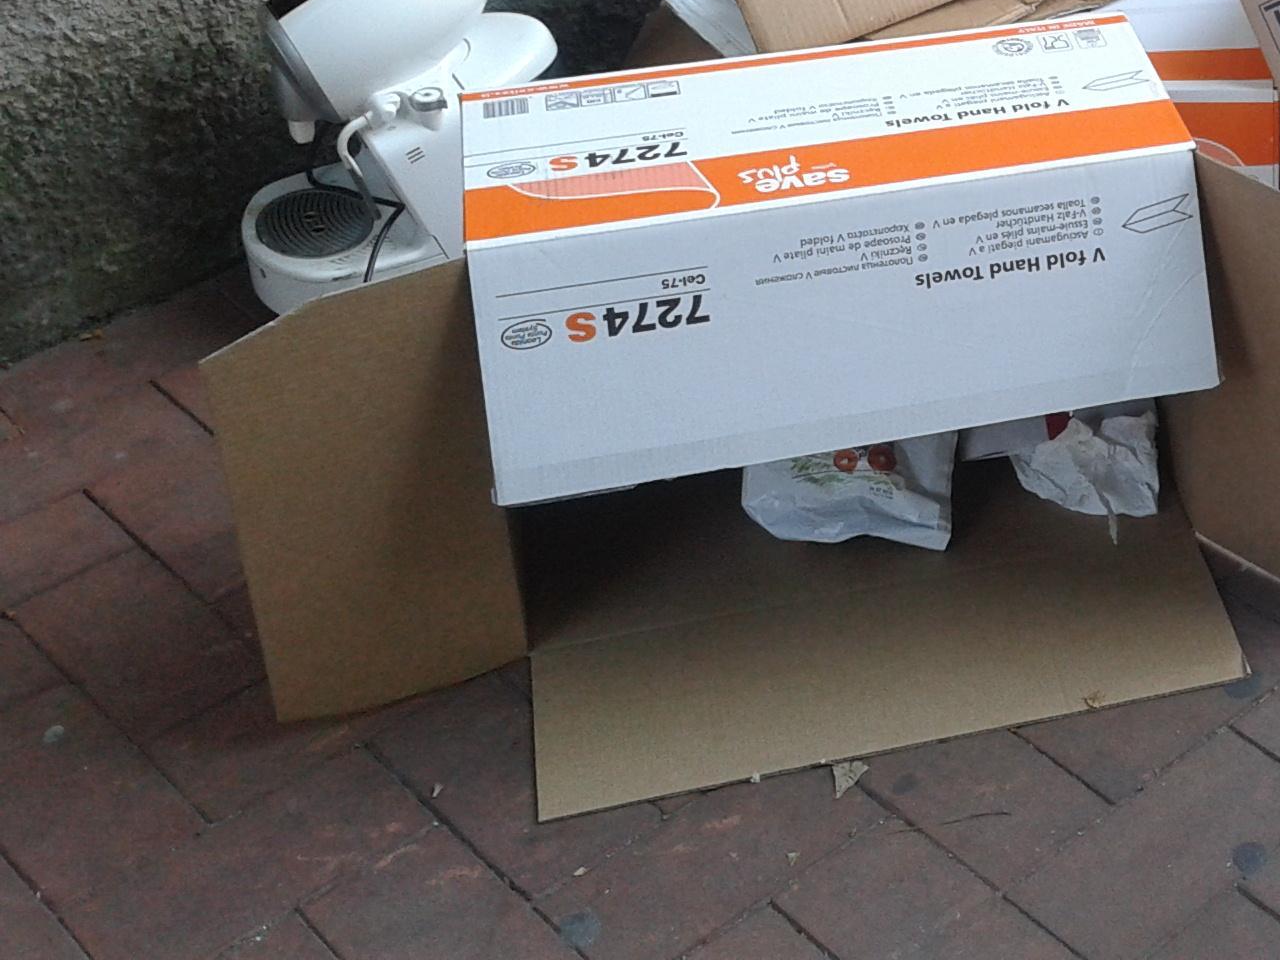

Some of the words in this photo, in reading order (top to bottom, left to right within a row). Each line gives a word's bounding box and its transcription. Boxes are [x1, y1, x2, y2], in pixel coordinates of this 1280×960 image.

[1010, 100, 1051, 113] fold
[1054, 98, 1069, 106] V
[956, 105, 1006, 119] Hand
[884, 112, 952, 128] Towels
[642, 130, 684, 141] Cel-75
[736, 154, 799, 185] plus
[753, 167, 851, 194] save
[1001, 202, 1053, 216] secamanos
[1057, 197, 1085, 209] Toalla
[958, 208, 998, 224] plegada
[994, 213, 1053, 229] Handtücher
[1056, 208, 1085, 220] V-Falz
[1026, 219, 1087, 236] Essuie-mains
[799, 234, 833, 248] folded
[863, 232, 910, 248] Prosoape
[985, 232, 997, 240] en
[1025, 227, 1088, 247] Asciugamani
[816, 243, 845, 256] maini
[848, 241, 861, 251] de
[987, 238, 1023, 253] piegati
[783, 246, 813, 261] pliate
[1046, 249, 1086, 270] fold
[1091, 246, 1105, 262] V
[989, 256, 1040, 279] Hand
[660, 273, 705, 289] Cel-75
[913, 264, 983, 290] Towels
